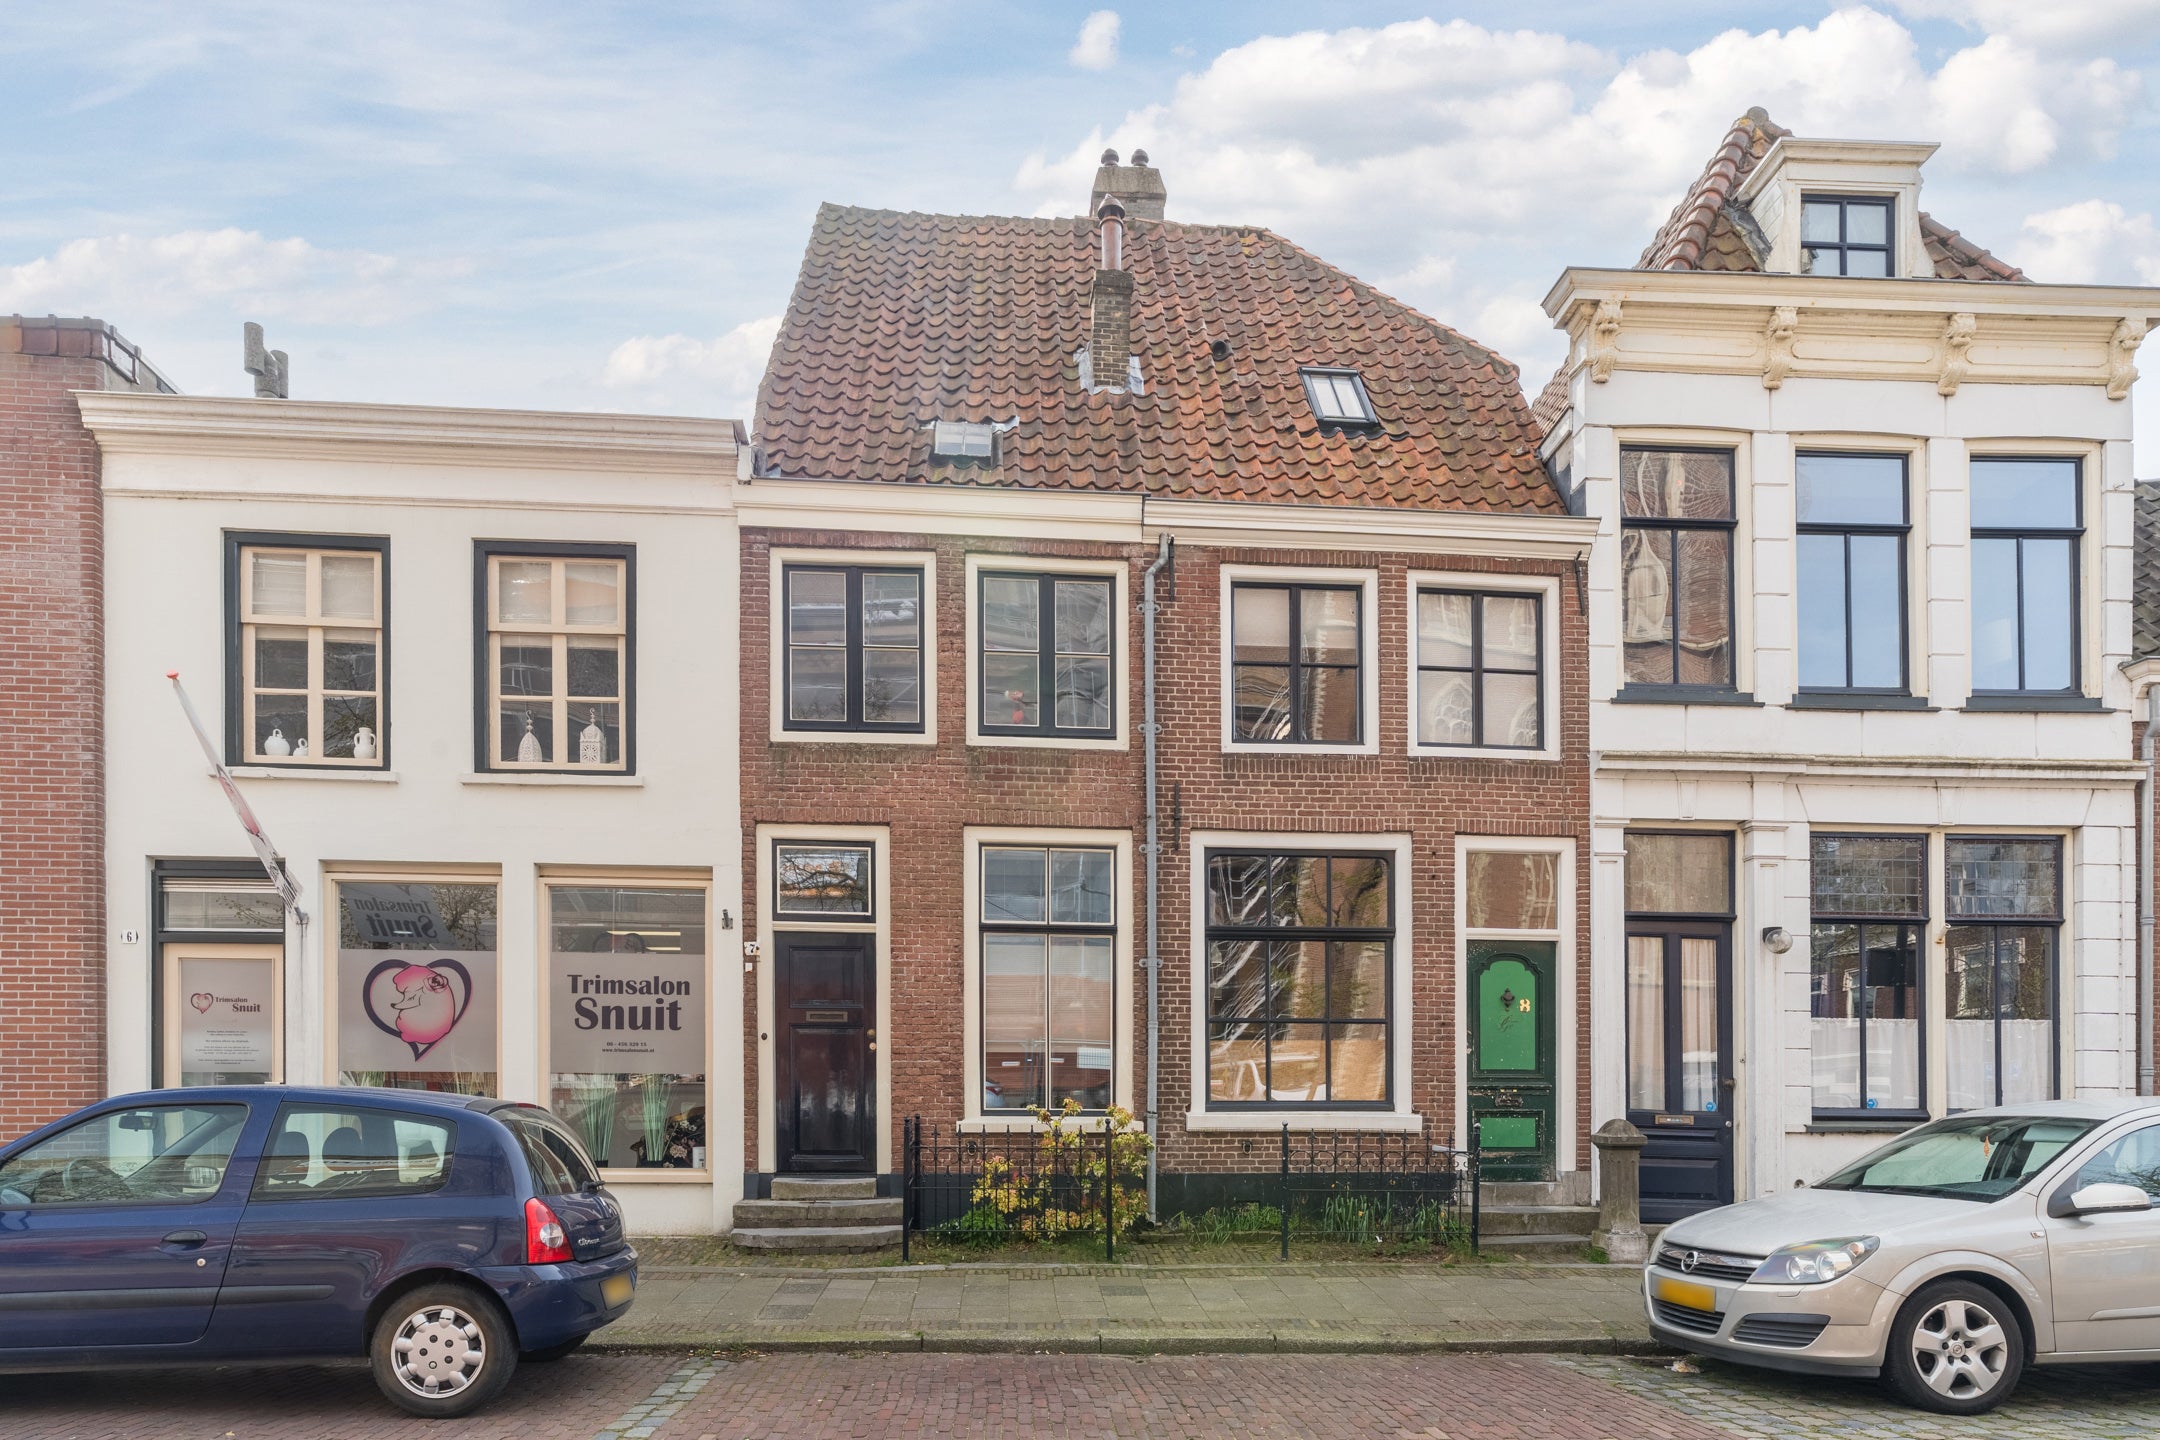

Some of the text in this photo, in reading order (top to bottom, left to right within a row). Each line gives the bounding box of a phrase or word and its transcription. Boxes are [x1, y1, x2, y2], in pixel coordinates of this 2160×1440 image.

[127, 931, 132, 942] 6
[567, 974, 690, 995] Trimsalon
[232, 1003, 261, 1013] Snuit
[1519, 999, 1531, 1012] 8
[575, 997, 682, 1031] Snuit
